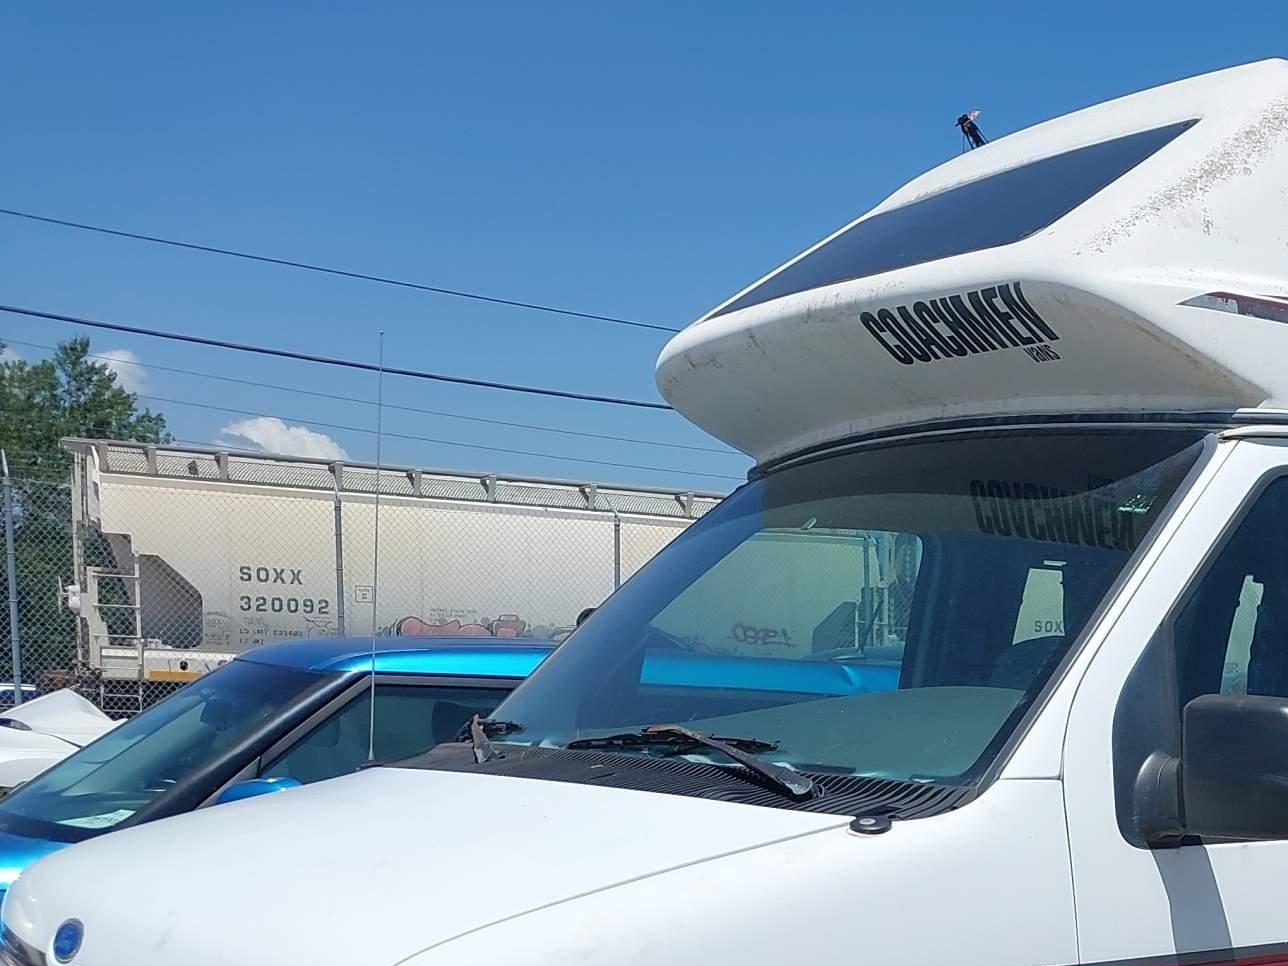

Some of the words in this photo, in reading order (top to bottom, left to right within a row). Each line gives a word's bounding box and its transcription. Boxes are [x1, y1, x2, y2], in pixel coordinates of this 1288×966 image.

[860, 280, 1060, 365] COACHMEN
[239, 566, 303, 585] SOXX
[239, 596, 330, 615] 320092
